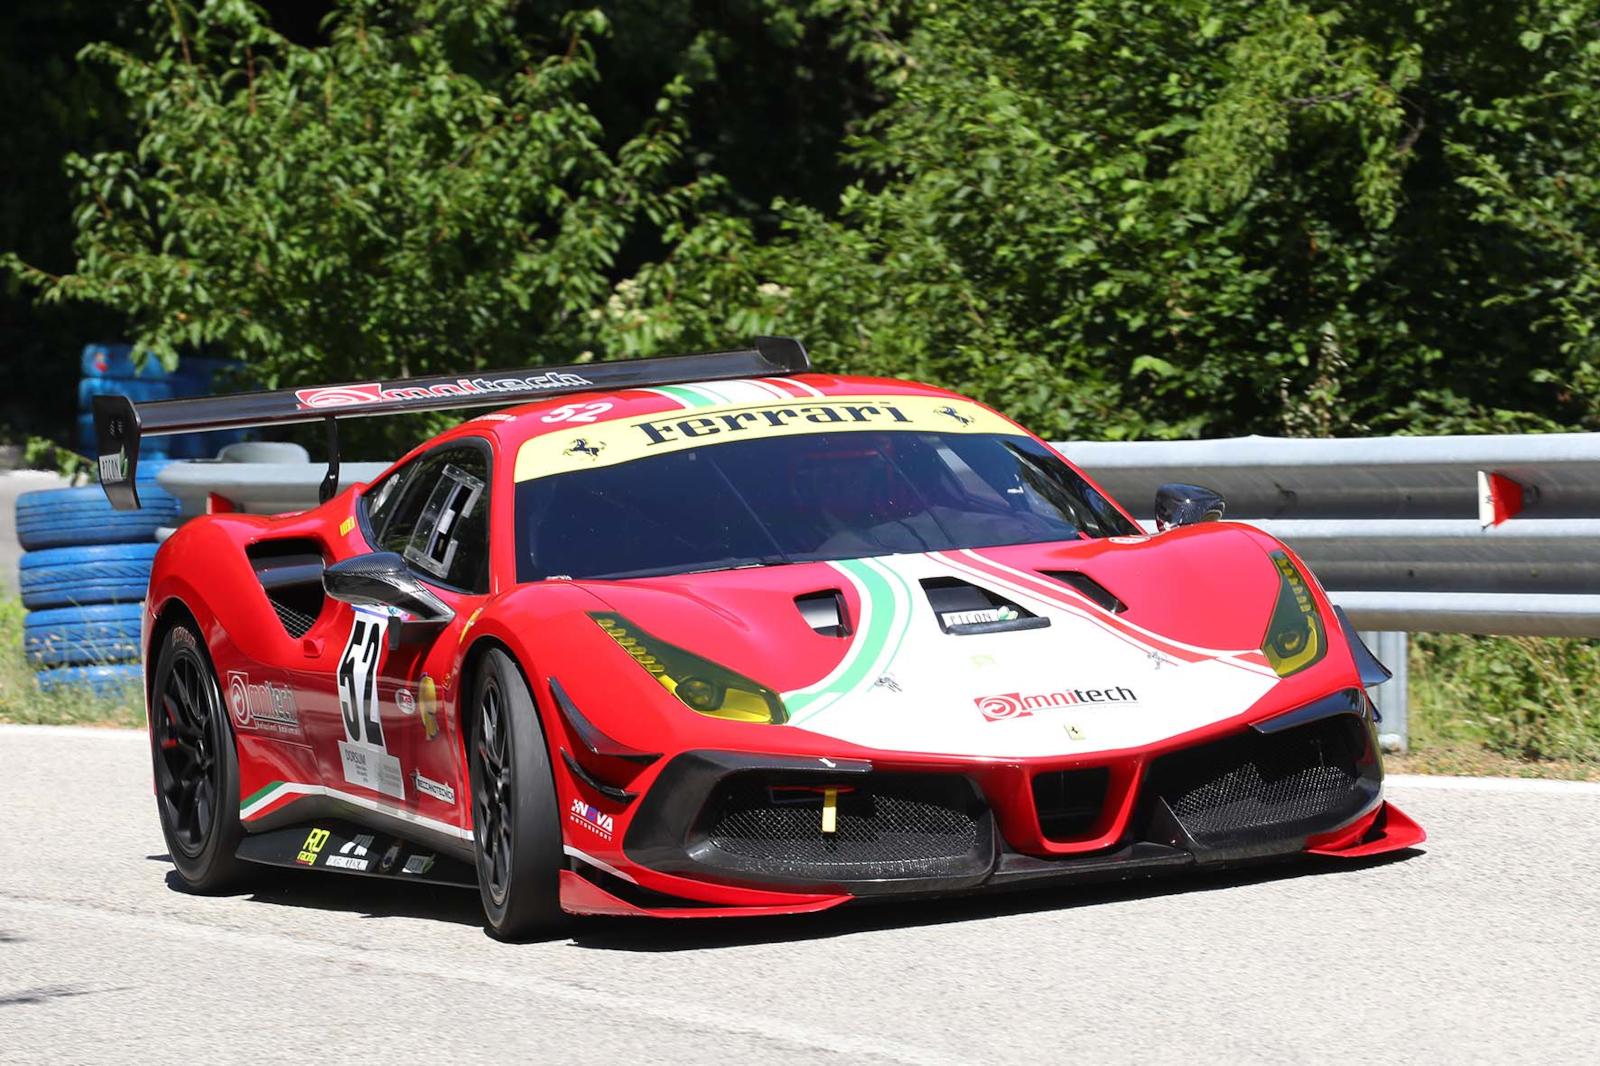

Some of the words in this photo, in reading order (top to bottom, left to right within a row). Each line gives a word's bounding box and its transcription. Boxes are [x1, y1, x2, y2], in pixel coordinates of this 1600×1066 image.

[541, 402, 613, 424] 52
[630, 400, 914, 447] Ferrari
[339, 619, 385, 747] 52
[569, 815, 612, 842] MOTORSPORT
[571, 799, 613, 832] NOVA
[302, 828, 331, 853] RO
